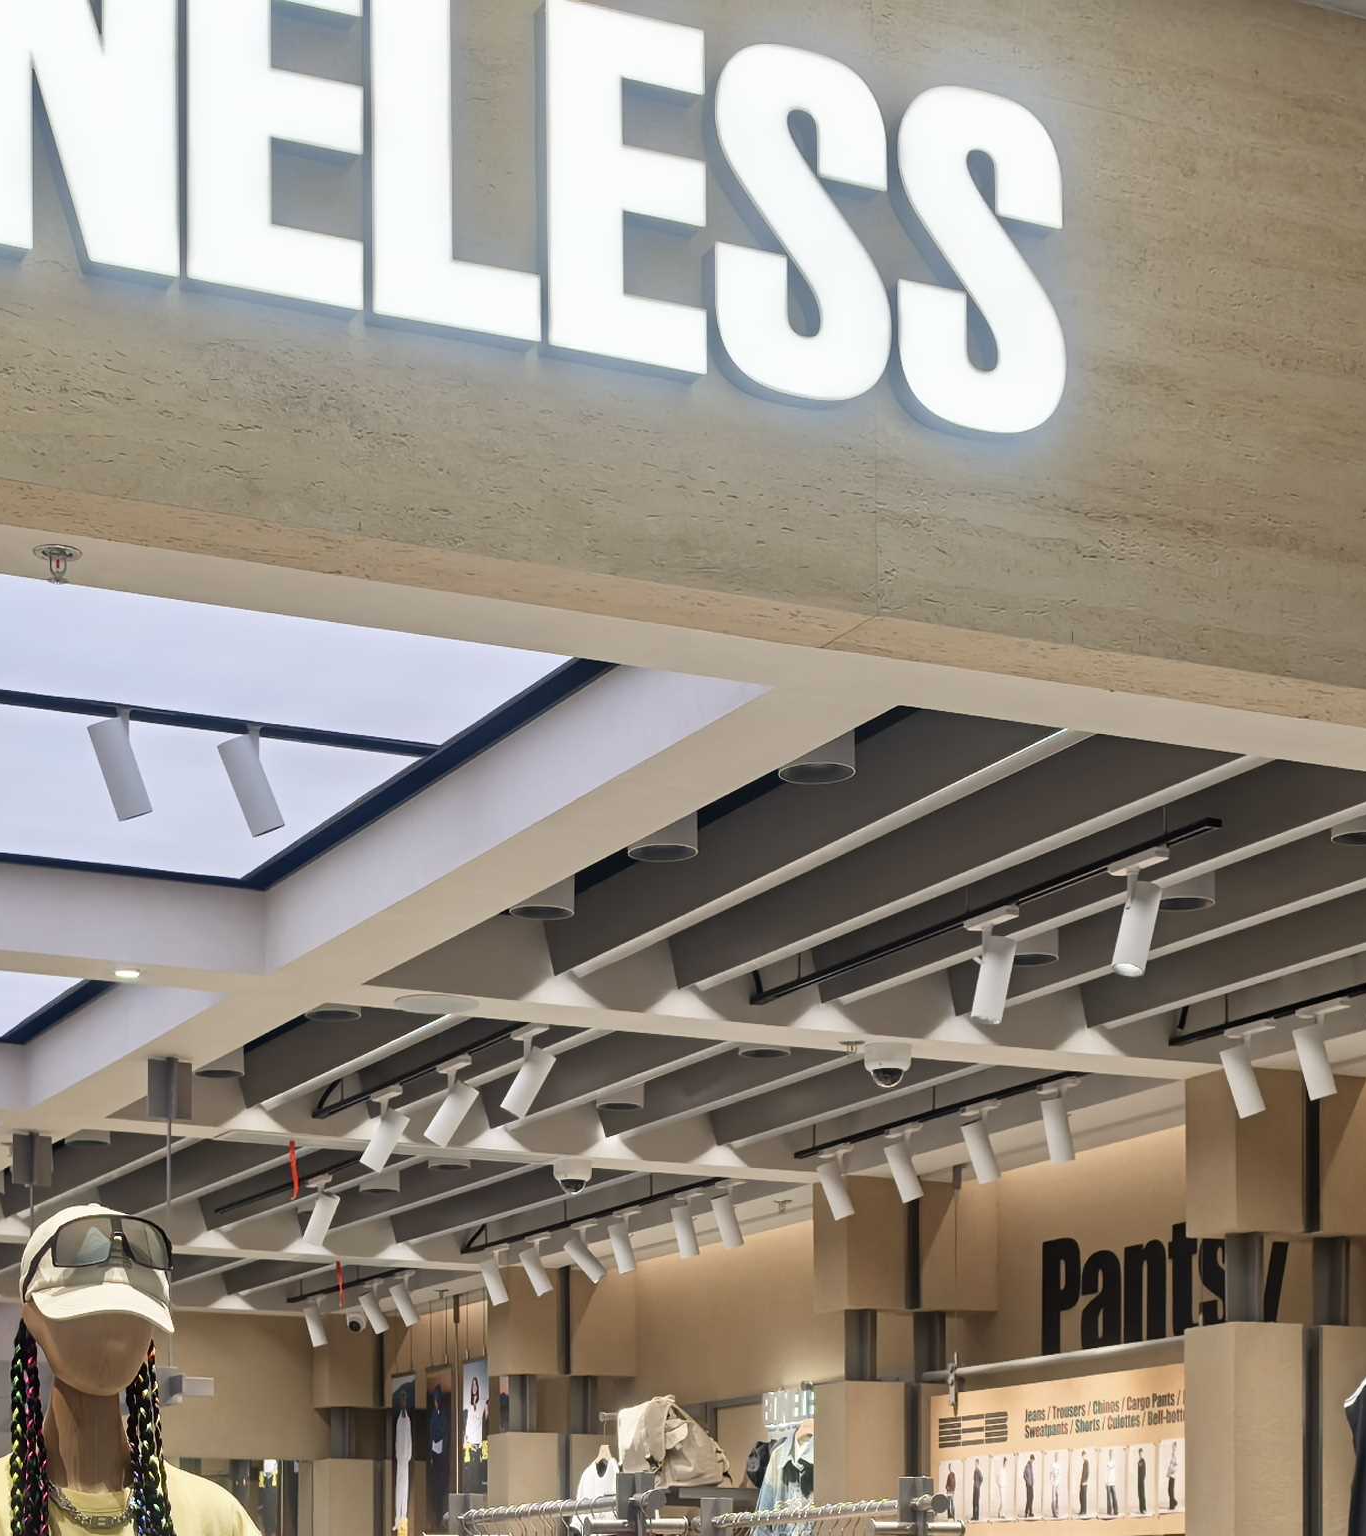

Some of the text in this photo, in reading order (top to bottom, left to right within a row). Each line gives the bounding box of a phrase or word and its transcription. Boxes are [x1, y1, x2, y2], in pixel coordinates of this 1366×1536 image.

[1042, 1222, 1227, 1356] Pants
[1025, 1409, 1046, 1422] Jeans
[1052, 1404, 1086, 1419] Trousers
[1126, 1396, 1151, 1411] Cargo
[1152, 1392, 1175, 1408] Pants
[1147, 1408, 1185, 1426] Bell-bott
